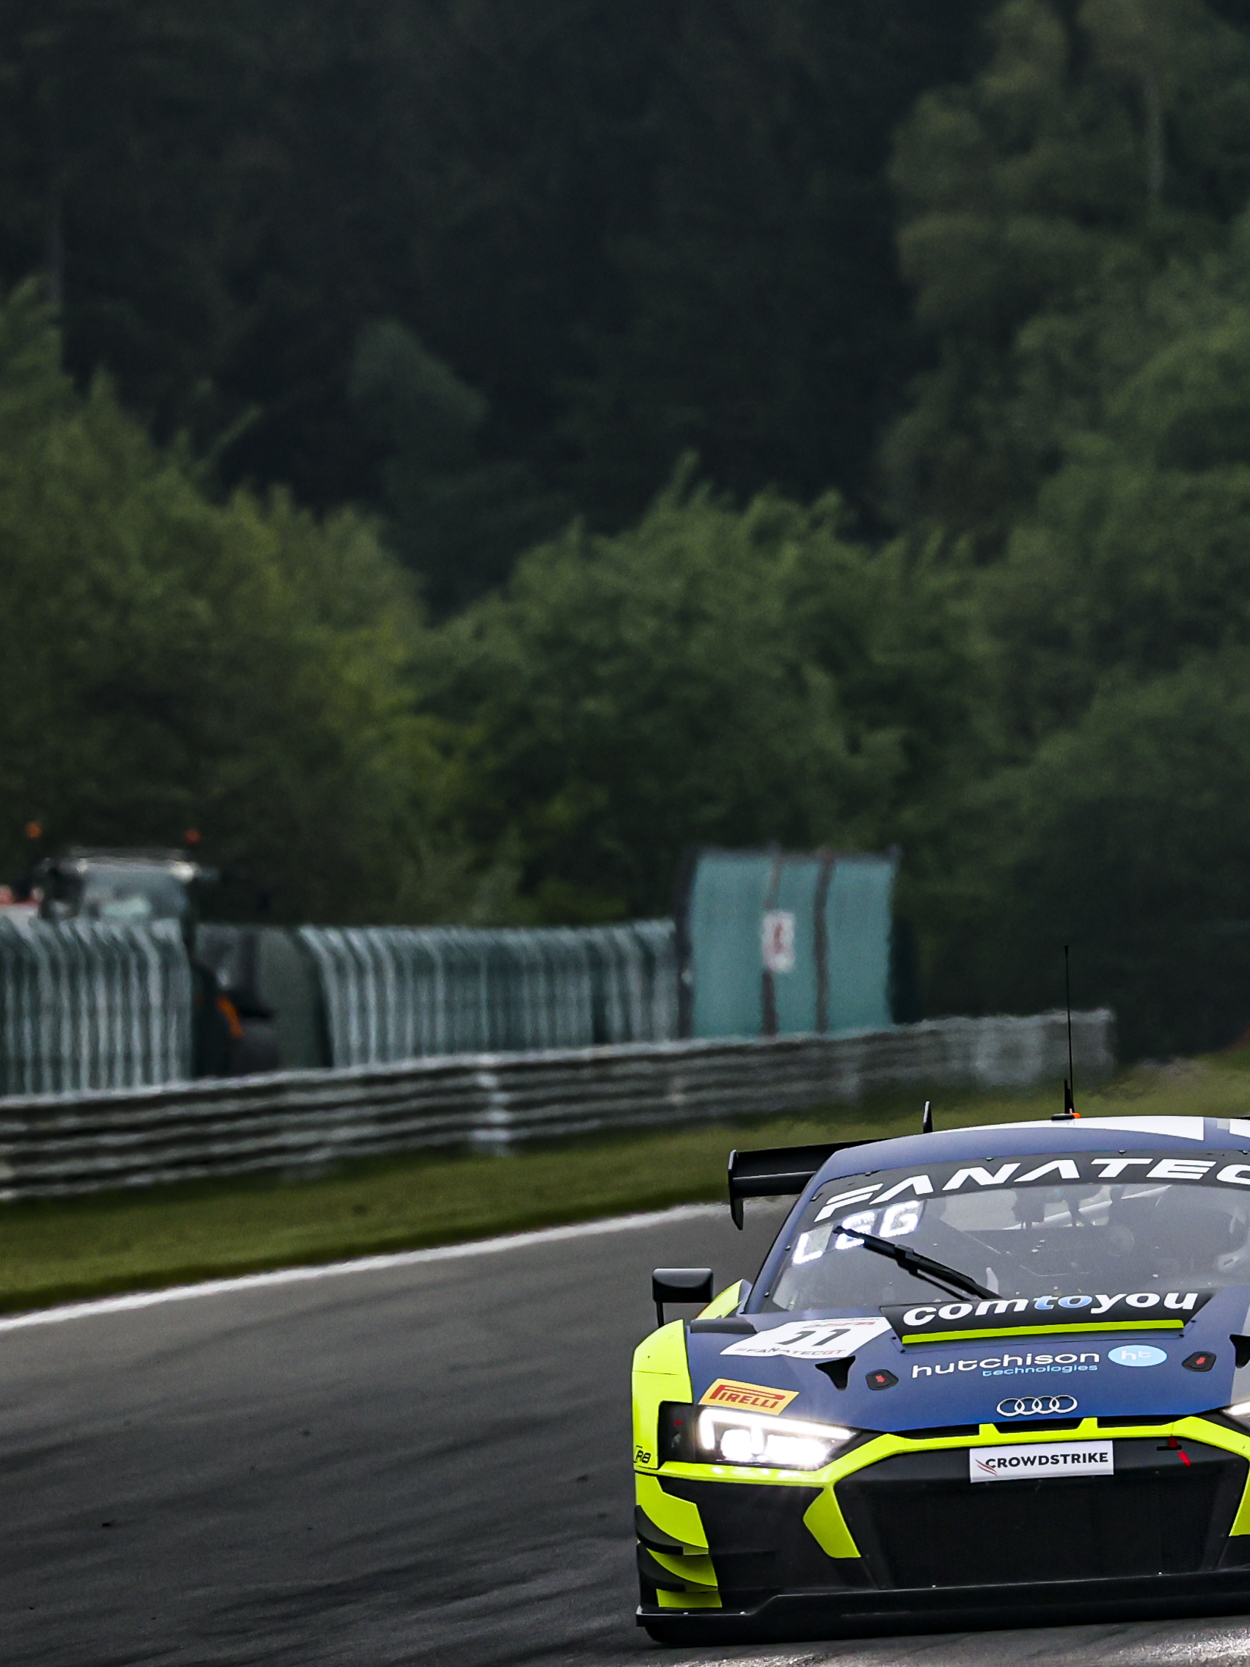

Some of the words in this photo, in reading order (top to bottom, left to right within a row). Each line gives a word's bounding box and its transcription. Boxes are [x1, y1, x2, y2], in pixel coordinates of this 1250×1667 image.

[902, 1292, 1198, 1327] comtoyou
[776, 1328, 851, 1347] 11
[911, 1352, 1100, 1379] hutchison
[982, 1364, 1098, 1377] technologies
[709, 1384, 786, 1409] PIRELLI
[984, 1451, 1109, 1470] CROWDSTRIKE
